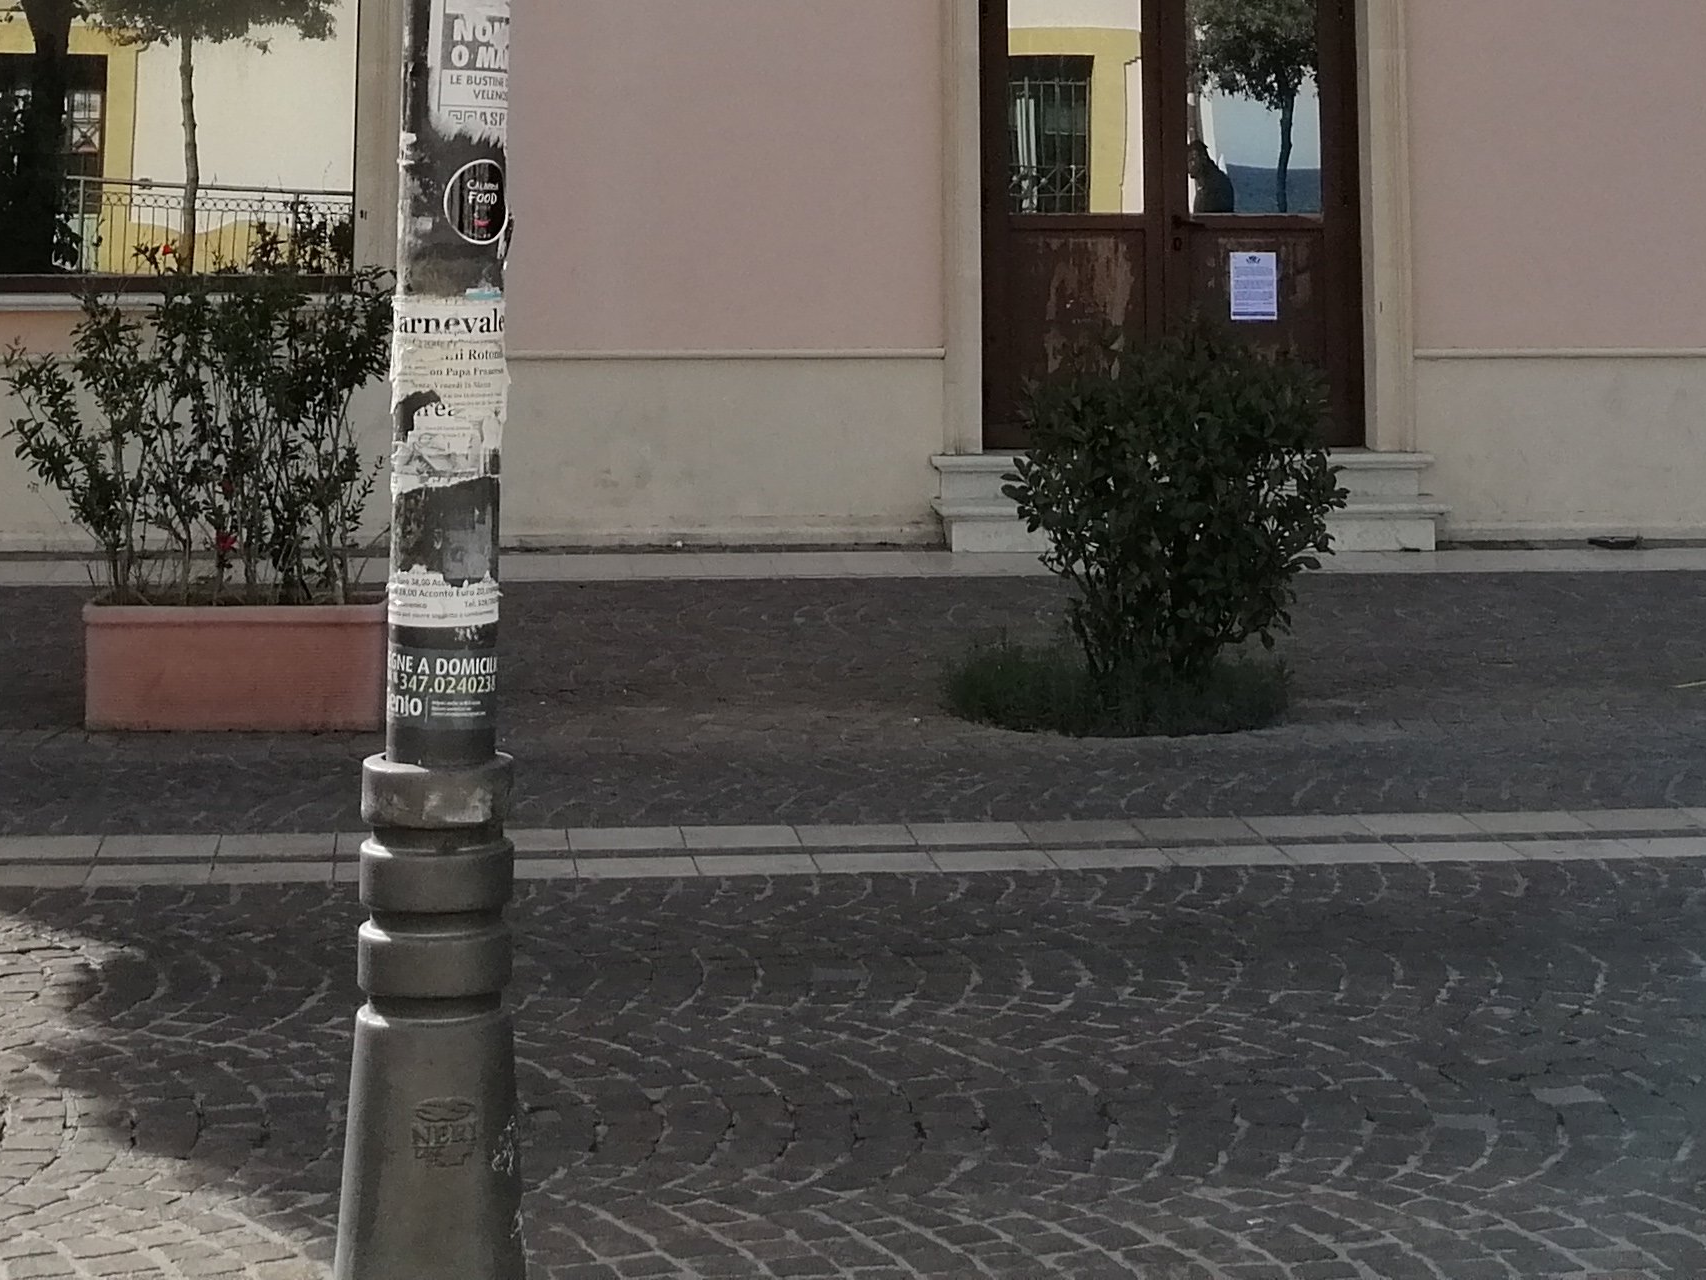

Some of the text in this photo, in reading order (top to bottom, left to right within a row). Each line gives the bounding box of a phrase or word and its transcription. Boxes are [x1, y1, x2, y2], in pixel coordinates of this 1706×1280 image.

[450, 74, 462, 85] LE
[468, 191, 497, 205] FOOD
[418, 589, 453, 598] Acconto
[417, 657, 430, 675] A
